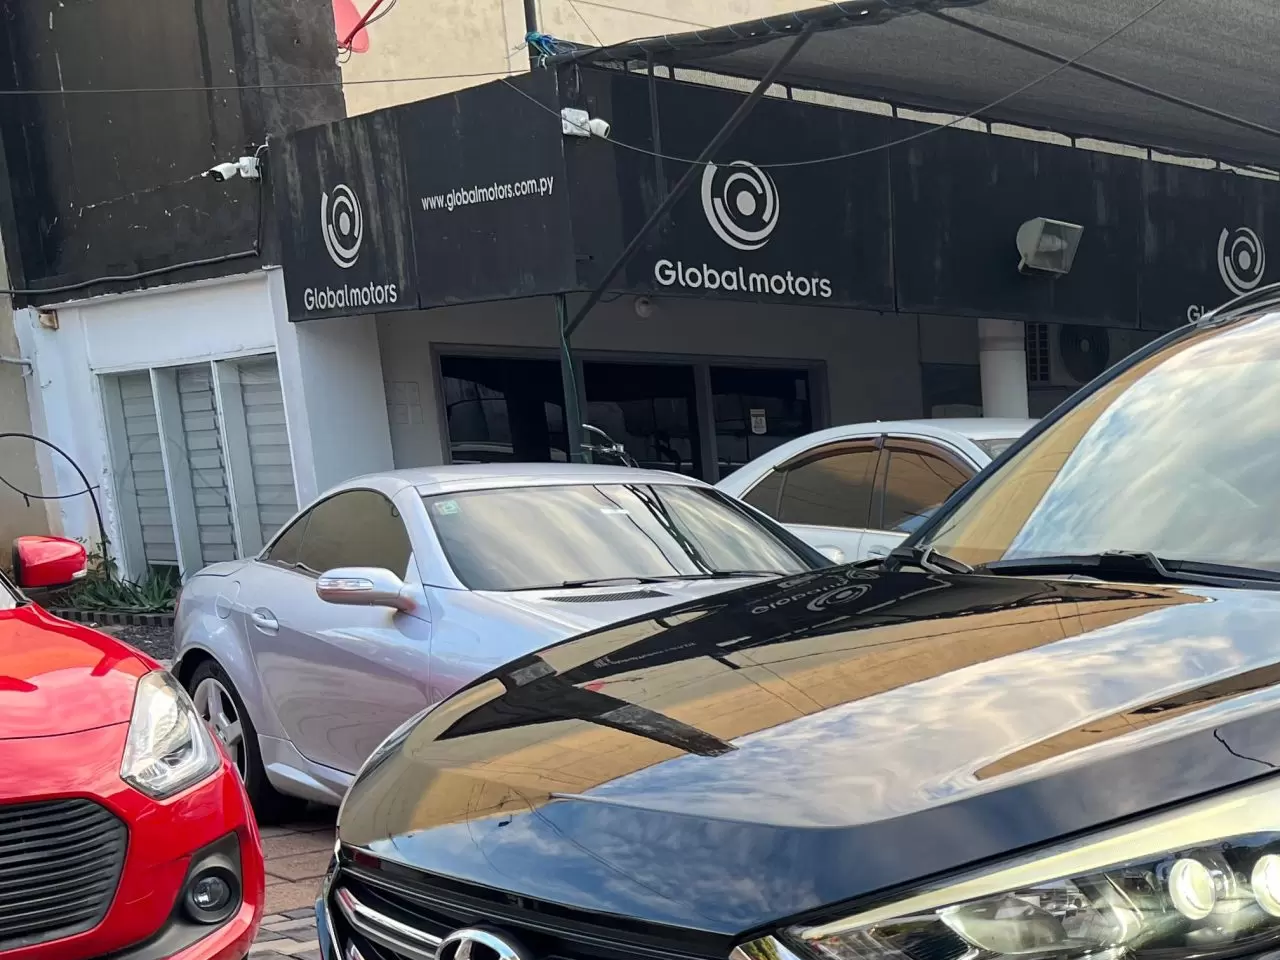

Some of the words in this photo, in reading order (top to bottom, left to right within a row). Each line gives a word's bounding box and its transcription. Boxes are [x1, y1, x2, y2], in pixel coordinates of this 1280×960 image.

[421, 175, 554, 211] www.globalmotors.com.py
[304, 281, 397, 311] Globalmotors
[654, 259, 832, 298] Globalmotors
